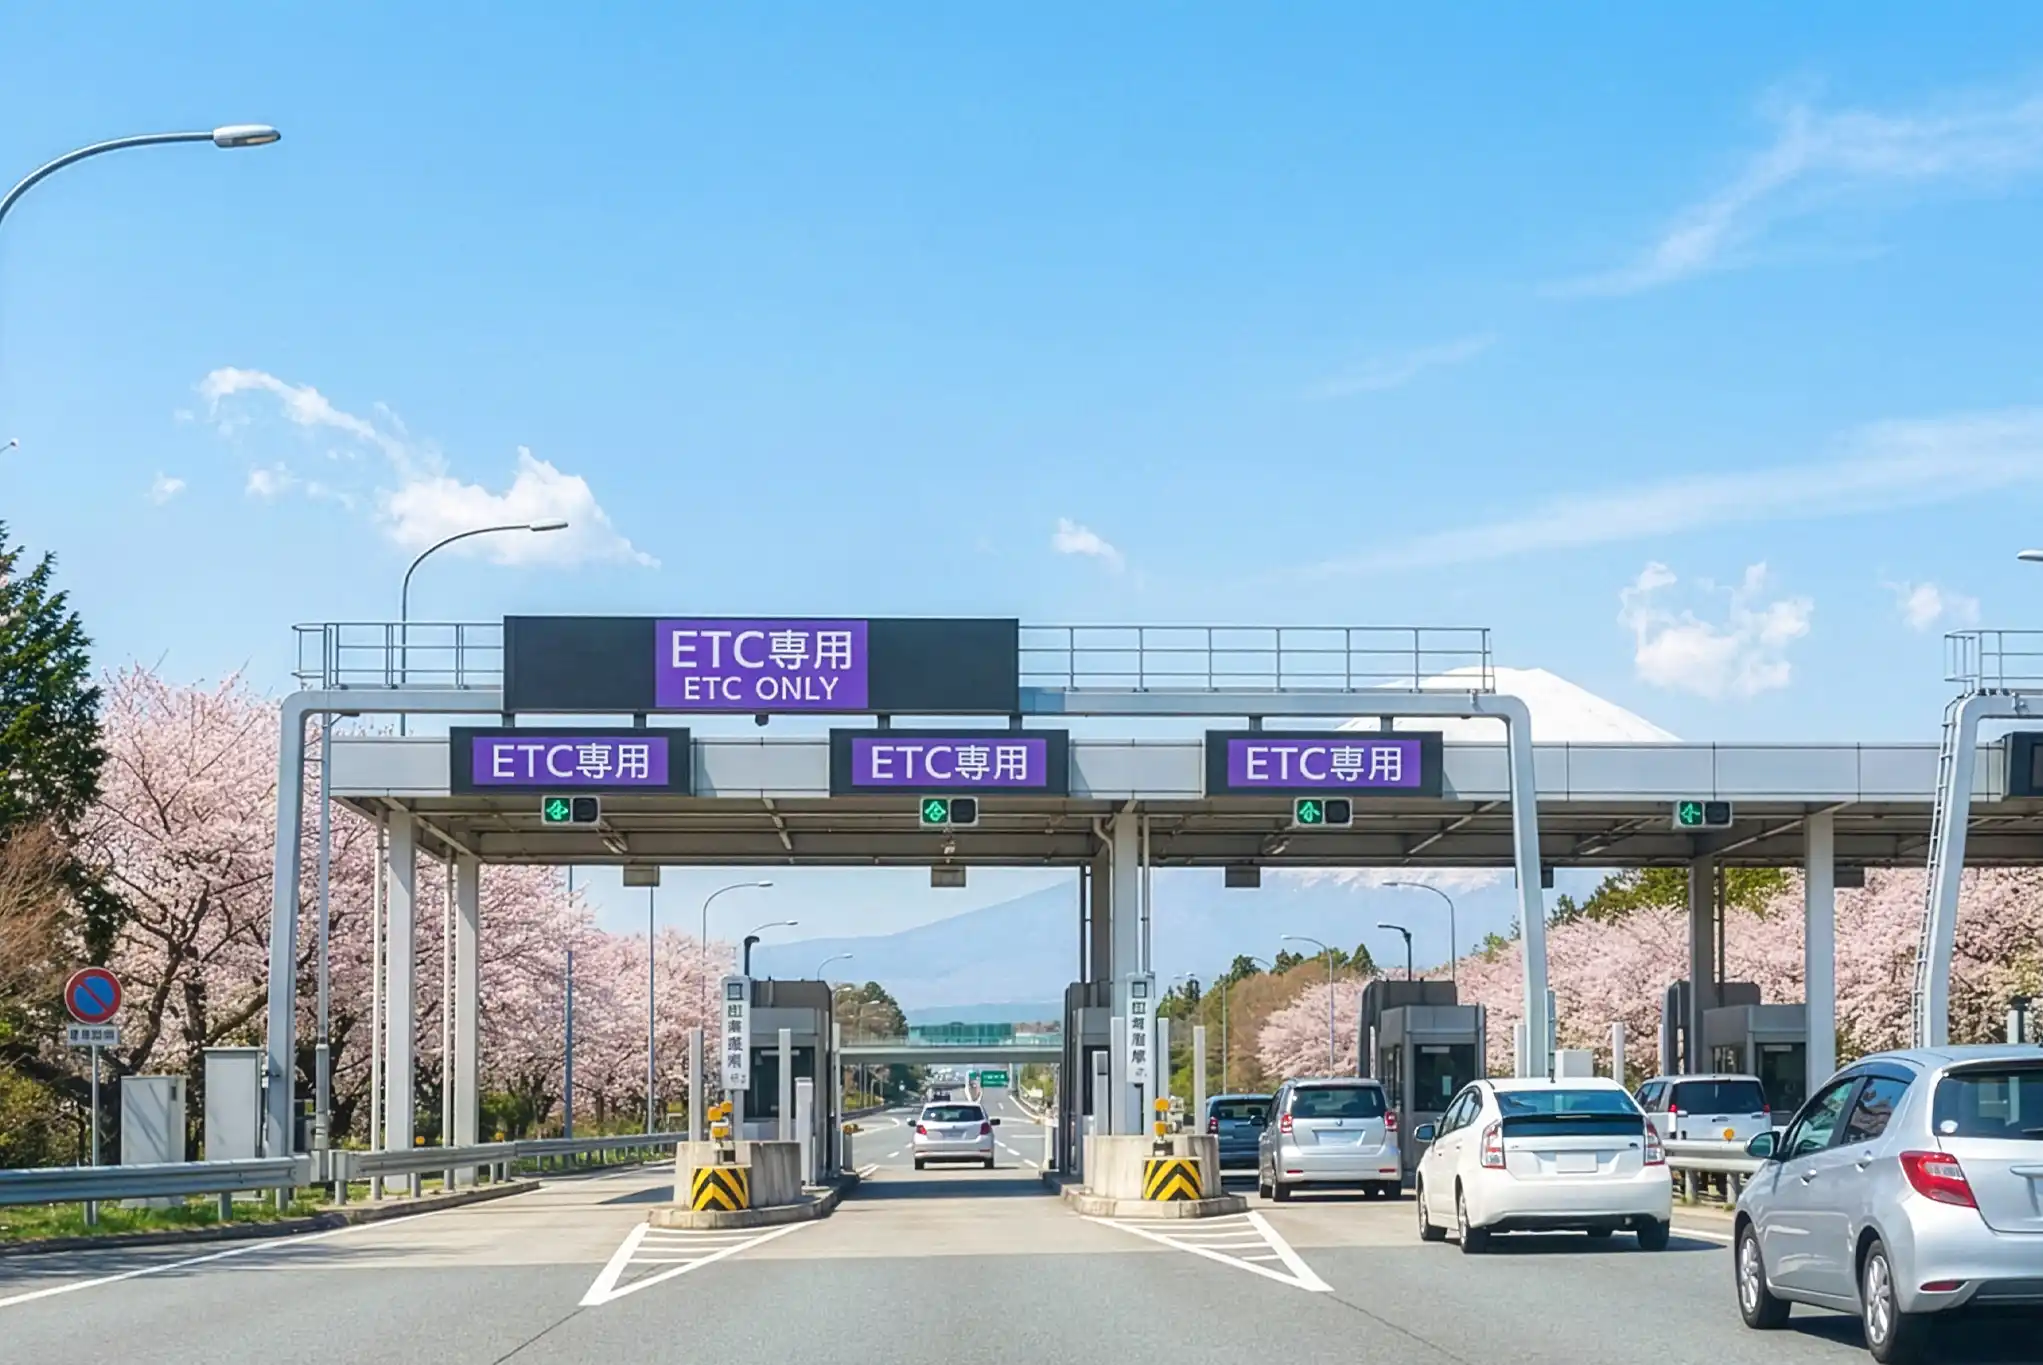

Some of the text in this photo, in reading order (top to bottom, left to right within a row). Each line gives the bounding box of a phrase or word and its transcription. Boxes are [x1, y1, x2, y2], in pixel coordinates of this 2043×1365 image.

[672, 629, 852, 670] ETC専用
[684, 676, 839, 701] ETC ONLY
[493, 742, 649, 779] ETC専用
[871, 744, 1027, 781] ETC専用
[1247, 745, 1402, 782] ETC専用
